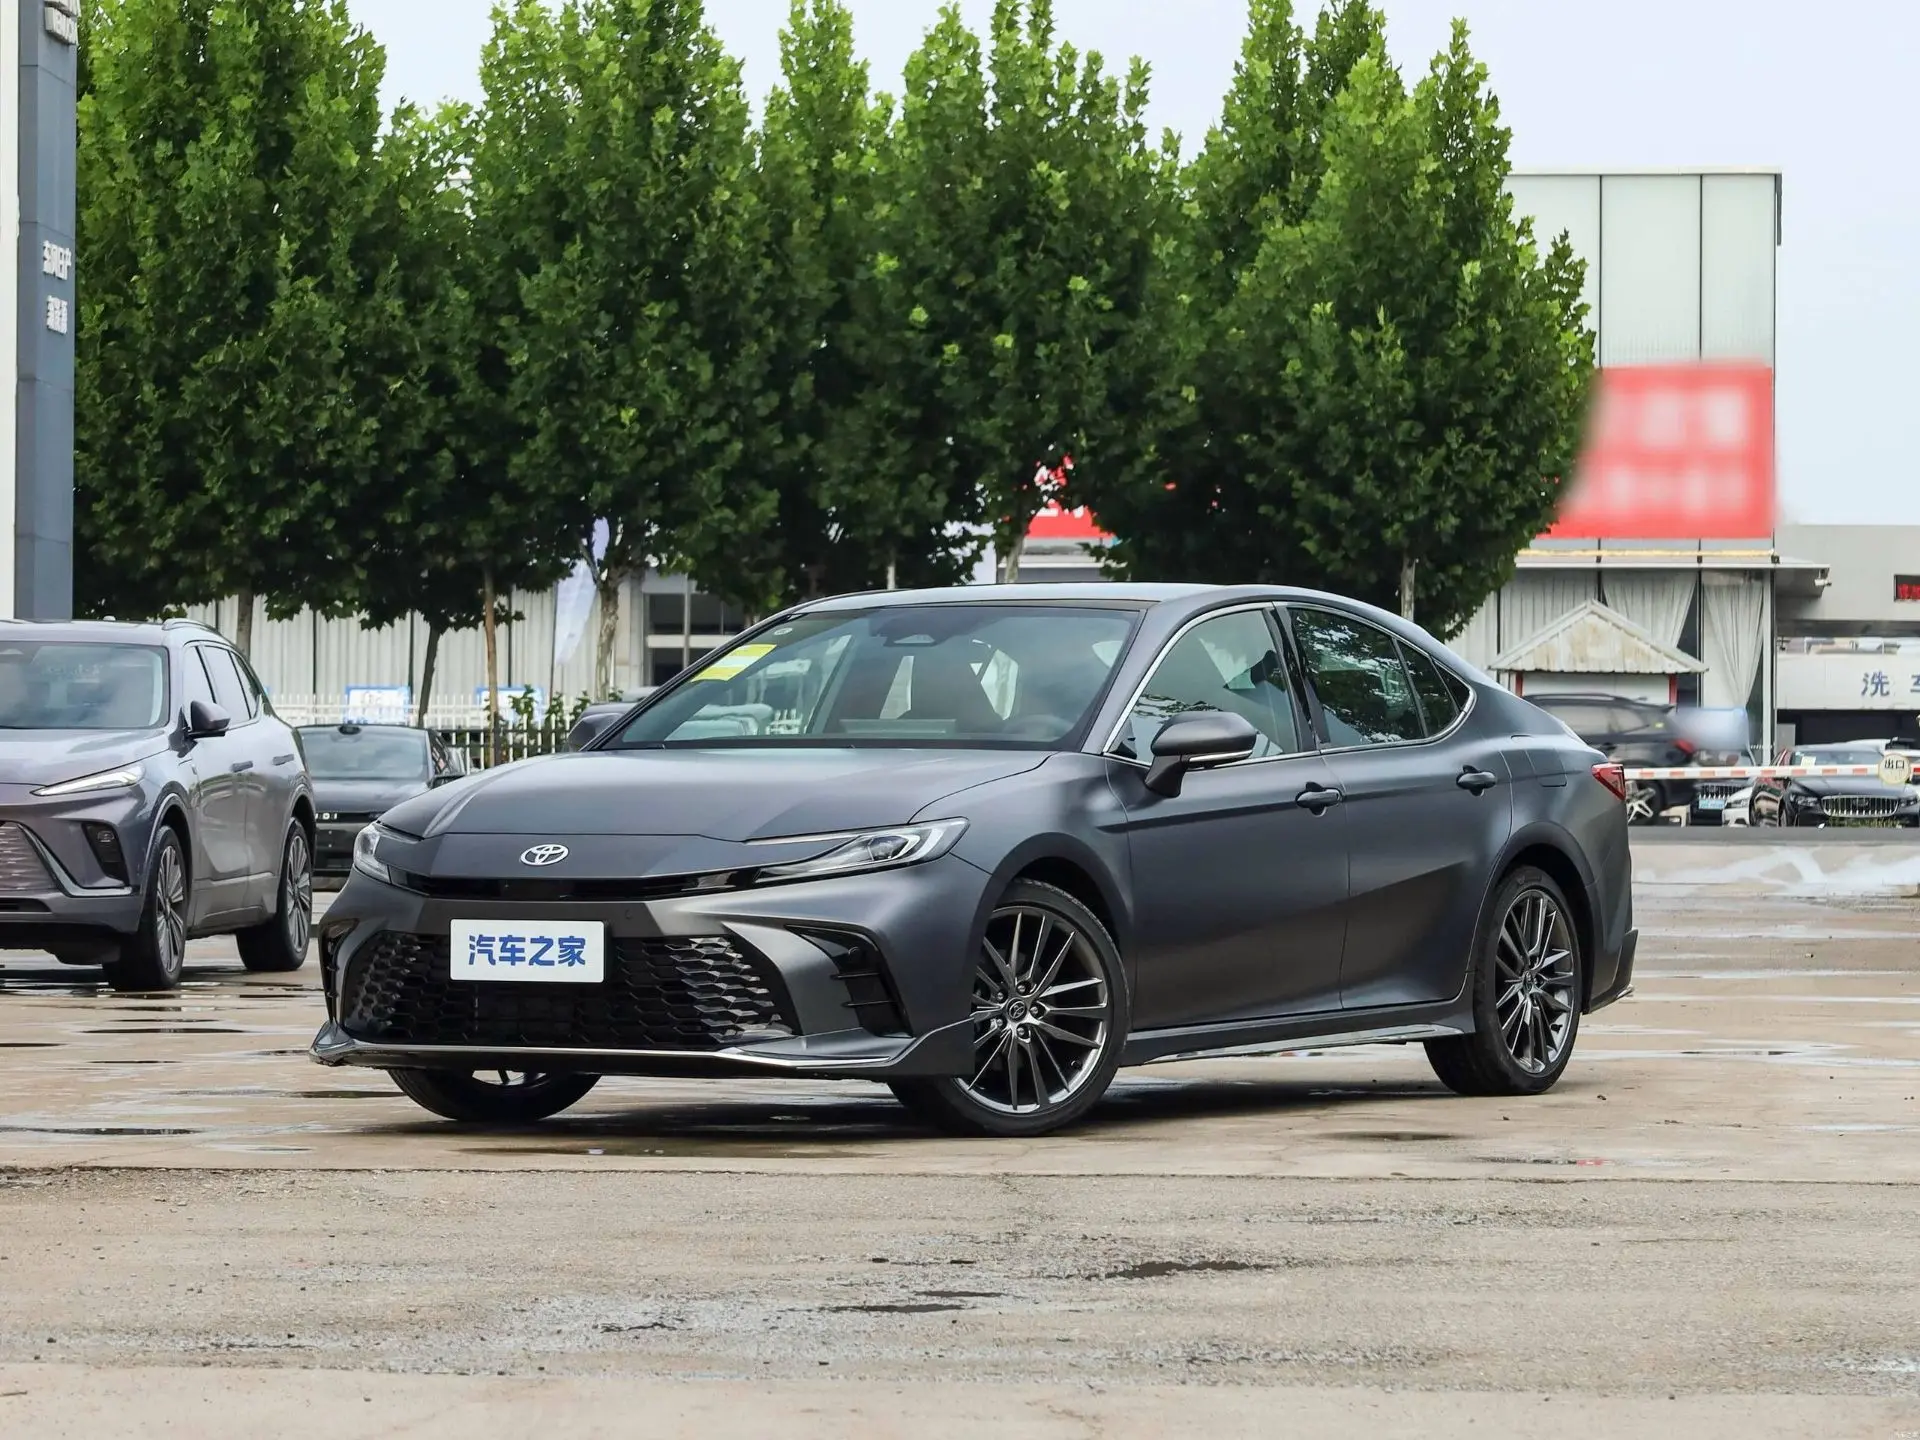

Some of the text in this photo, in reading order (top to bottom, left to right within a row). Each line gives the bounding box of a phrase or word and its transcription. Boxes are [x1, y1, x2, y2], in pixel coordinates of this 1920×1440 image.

[1884, 757, 1905, 769] 出口
[468, 934, 586, 967] 汽车之家
